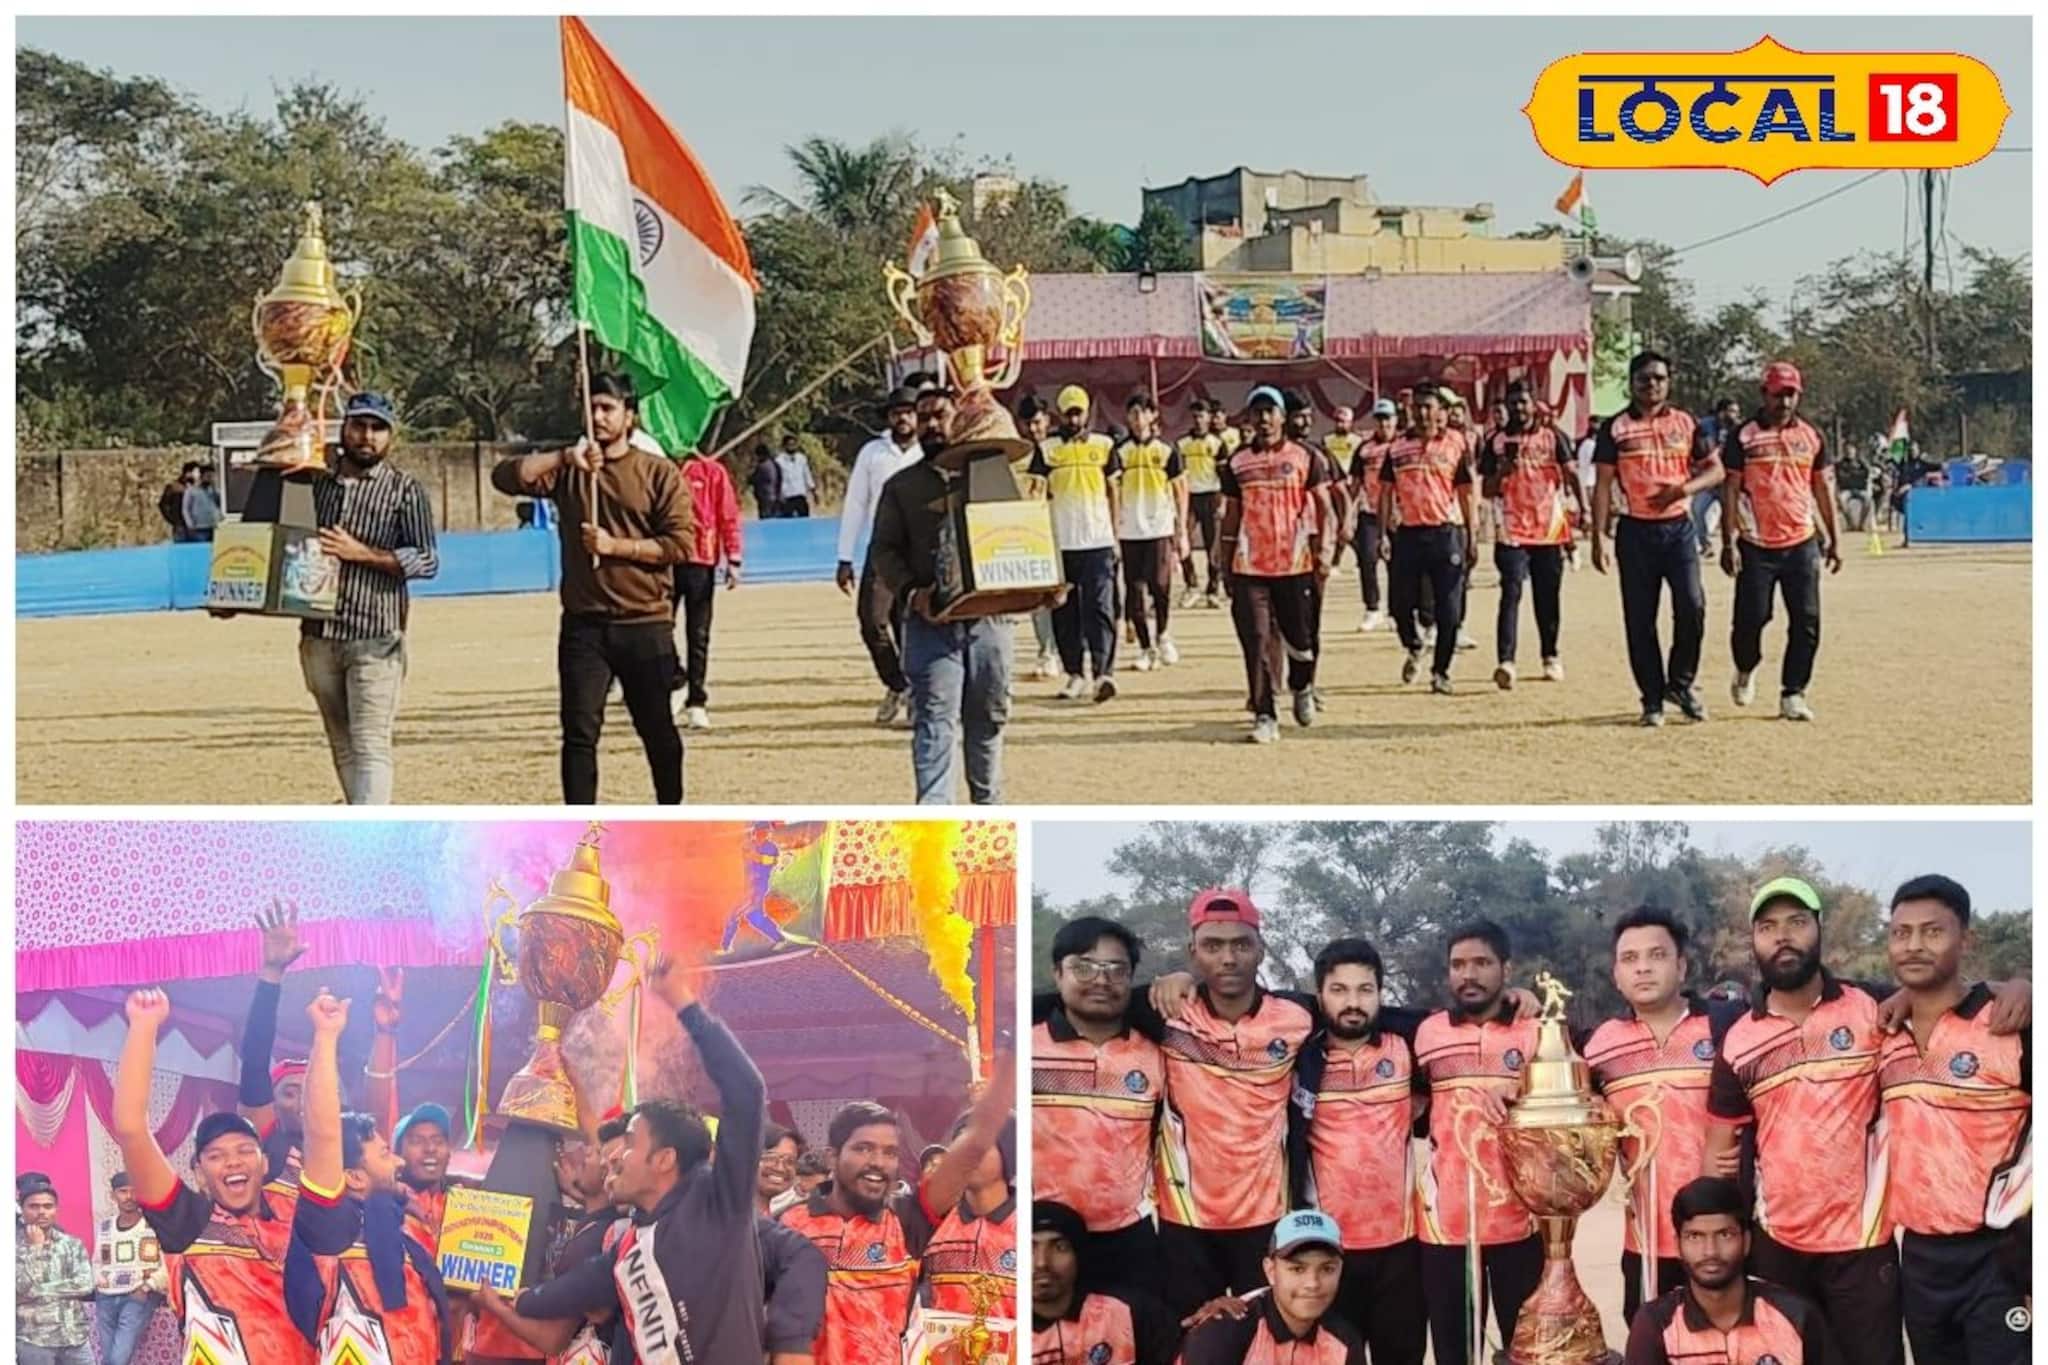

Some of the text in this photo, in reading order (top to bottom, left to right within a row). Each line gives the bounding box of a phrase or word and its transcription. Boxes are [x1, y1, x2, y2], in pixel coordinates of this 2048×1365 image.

[979, 559, 1052, 583] WINNER
[211, 581, 263, 602] RUNNER
[441, 1253, 517, 1290] WINNER
